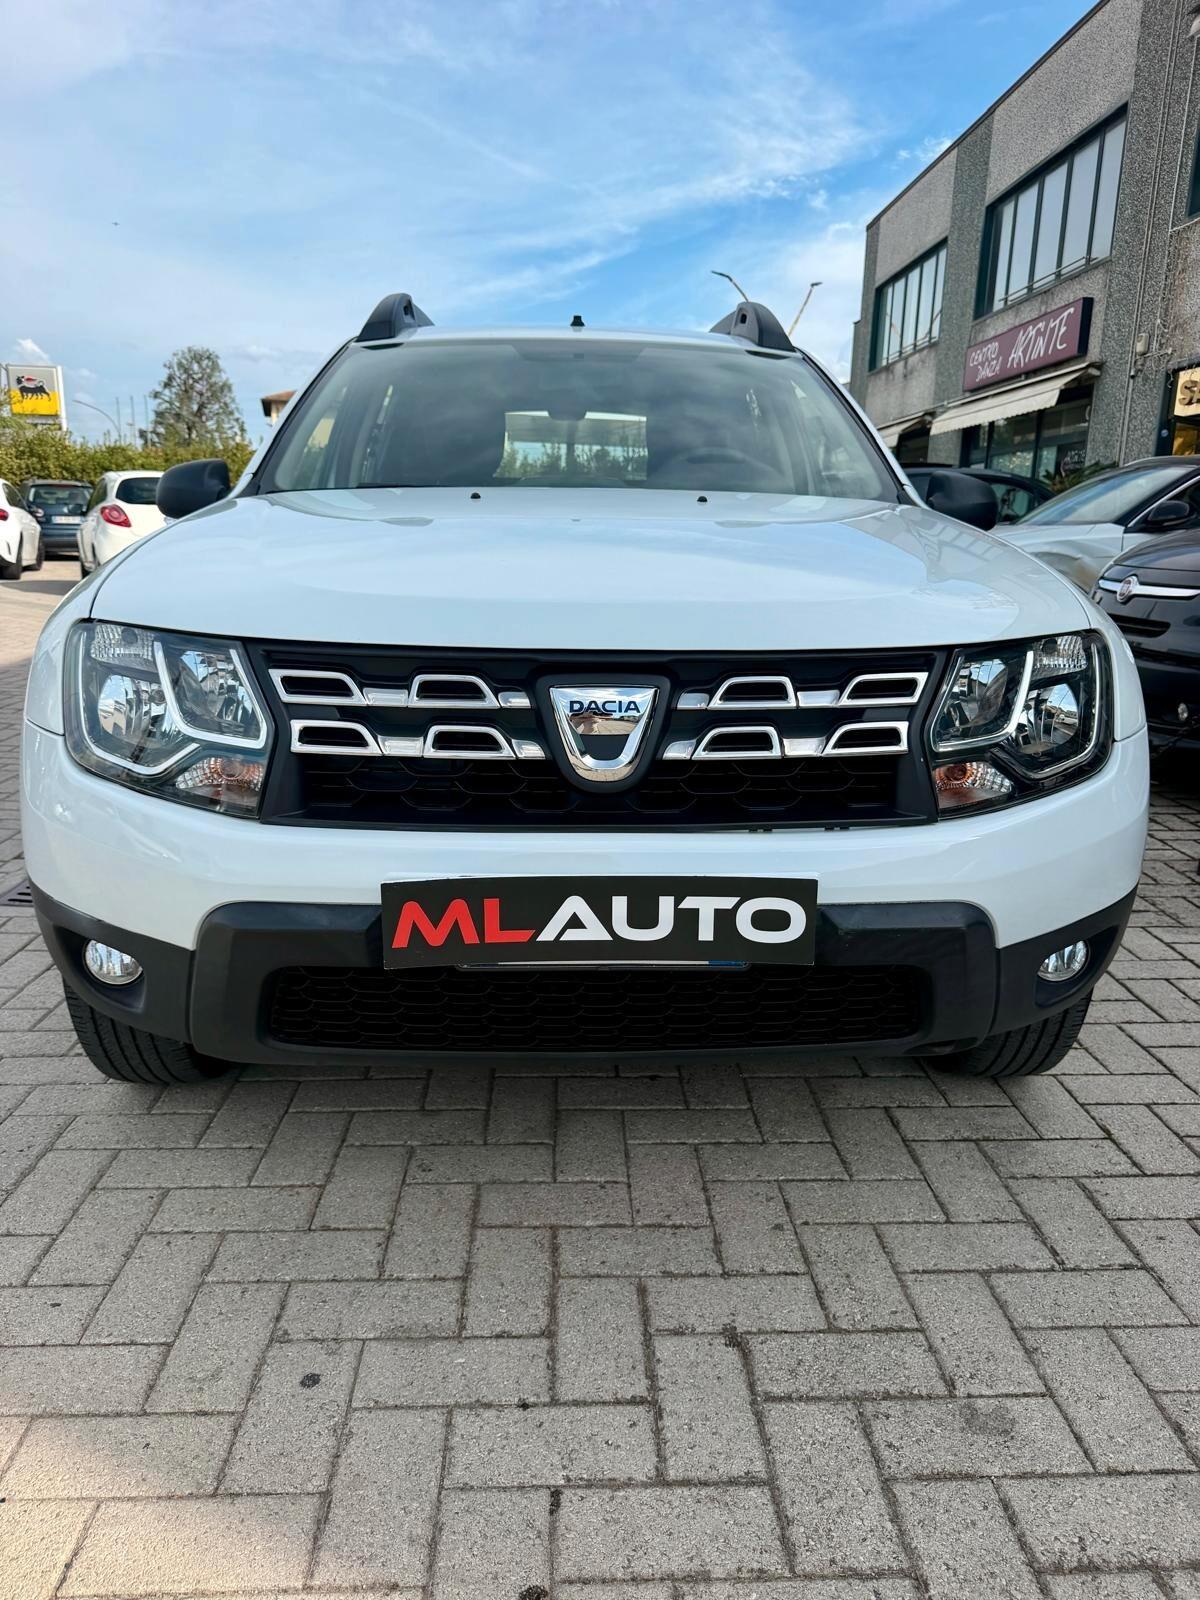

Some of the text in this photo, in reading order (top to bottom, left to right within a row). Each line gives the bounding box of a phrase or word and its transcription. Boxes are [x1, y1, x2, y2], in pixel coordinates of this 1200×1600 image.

[969, 341, 1000, 367] CENTRO
[976, 355, 1003, 382] DANZA
[569, 700, 641, 713] DACIA
